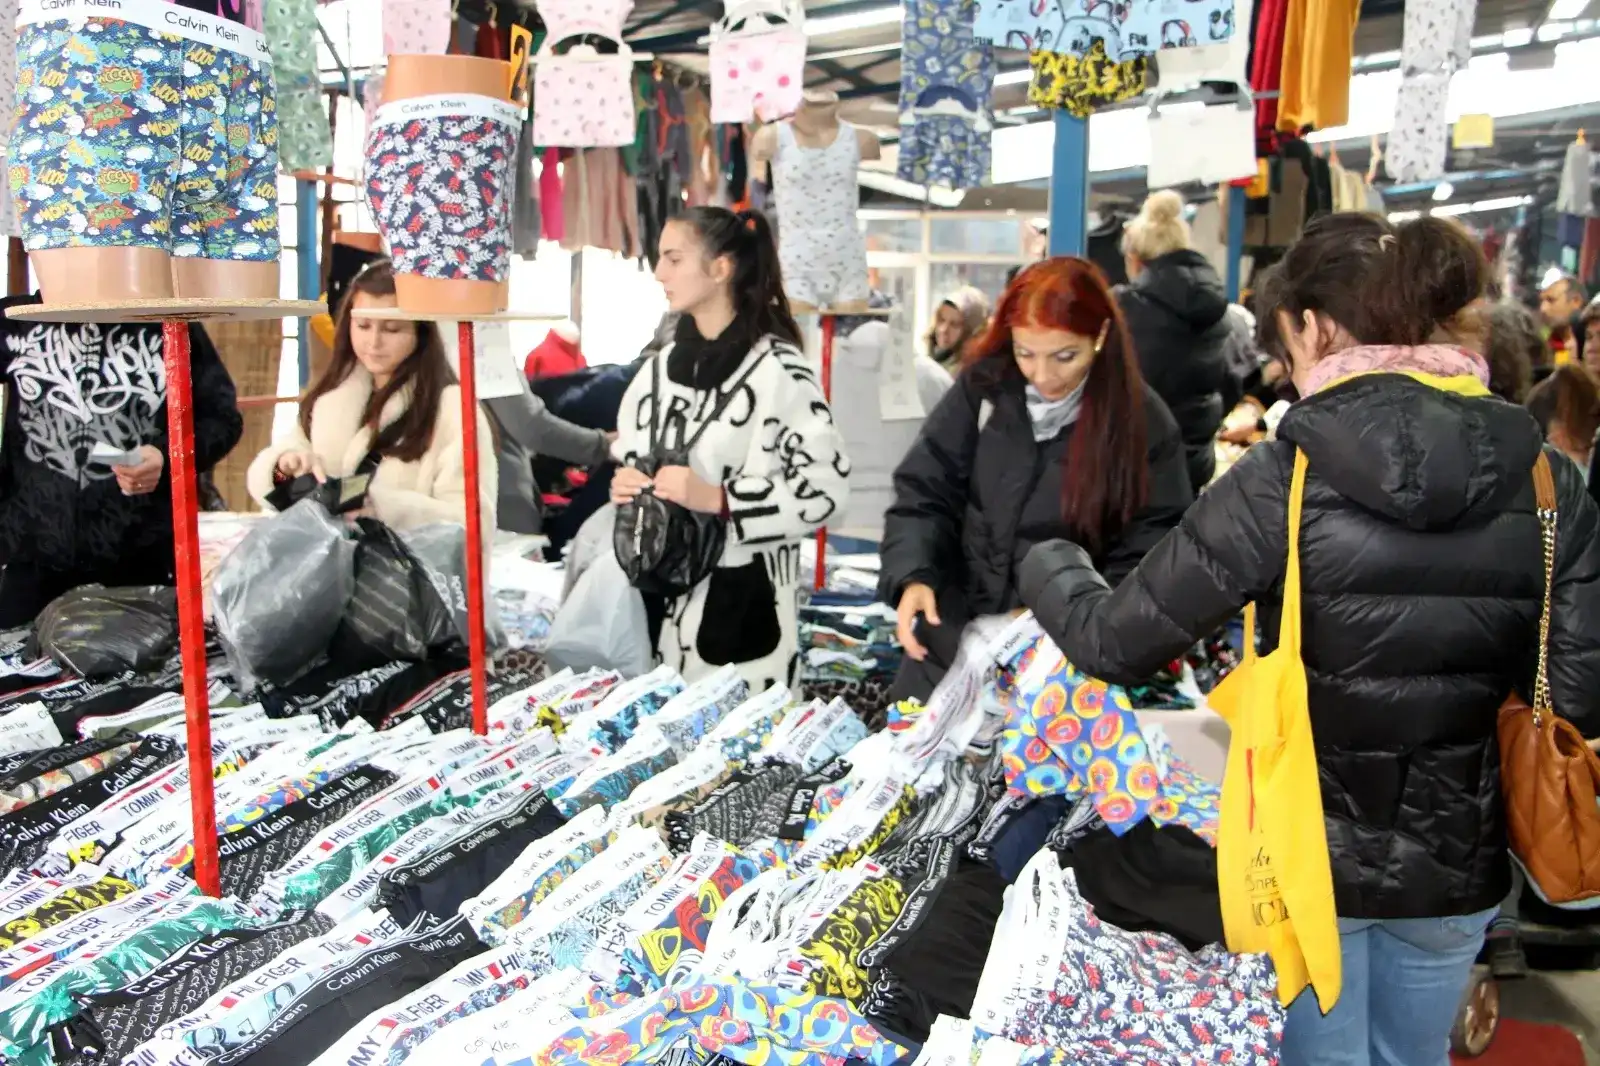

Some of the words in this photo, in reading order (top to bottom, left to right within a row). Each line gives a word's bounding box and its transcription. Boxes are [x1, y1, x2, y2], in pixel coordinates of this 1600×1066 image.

[164, 11, 209, 34] Calvin
[215, 24, 240, 43] Klein
[401, 103, 435, 114] Calvin
[440, 100, 467, 108] Klein
[102, 760, 143, 795] Calvin
[461, 762, 501, 787] TOMMY
[120, 788, 164, 818] TOMMY
[308, 784, 350, 810] Calvin
[345, 774, 372, 795] Klein
[49, 802, 91, 824] Klein
[256, 814, 295, 840] Klein
[328, 808, 387, 845] HILFIGER
[63, 820, 105, 844] FIGER
[0, 886, 50, 915] TOMMY
[341, 866, 382, 902] TOMMY
[643, 882, 686, 917] TOMMY
[33, 916, 107, 949] HILFIGER
[127, 959, 196, 996] Calvin
[190, 935, 241, 960] Klein
[231, 956, 307, 999] HILFIGER
[326, 961, 375, 991] Calvin
[370, 949, 402, 972] Klein
[394, 993, 451, 1025] HILFIGER
[218, 1031, 272, 1065] Calvin
[270, 1002, 309, 1034] Klein
